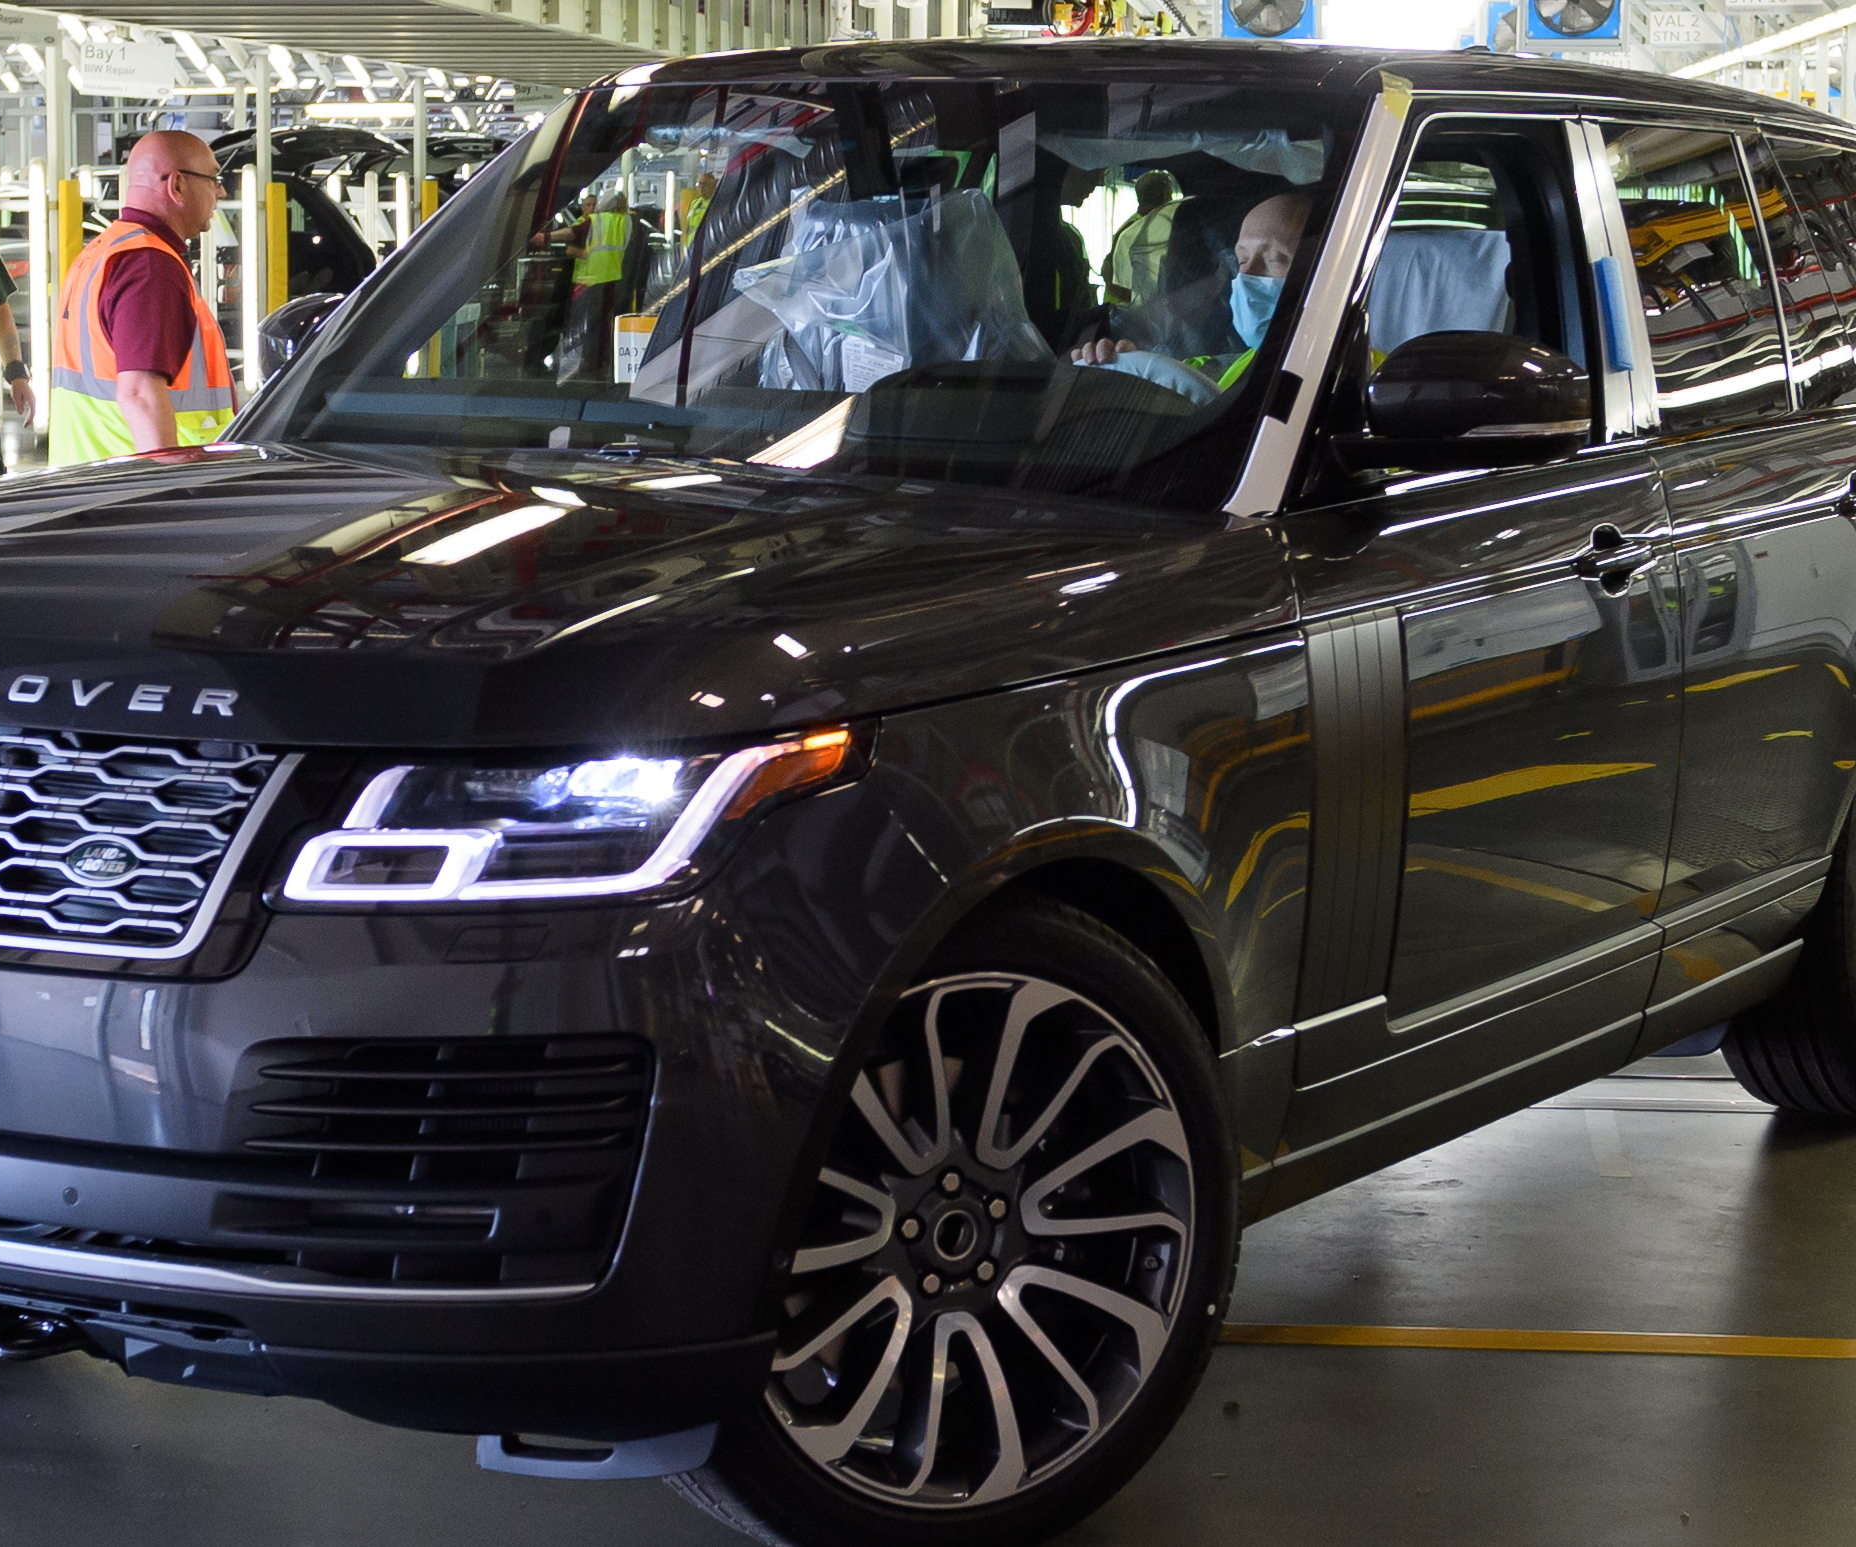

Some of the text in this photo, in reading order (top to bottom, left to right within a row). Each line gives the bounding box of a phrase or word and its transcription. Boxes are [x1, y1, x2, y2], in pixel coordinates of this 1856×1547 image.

[1654, 15, 1699, 27] VAL 2
[1653, 31, 1700, 42] STN 12
[85, 45, 126, 63] Bay 1
[84, 64, 136, 76] BIW Repair
